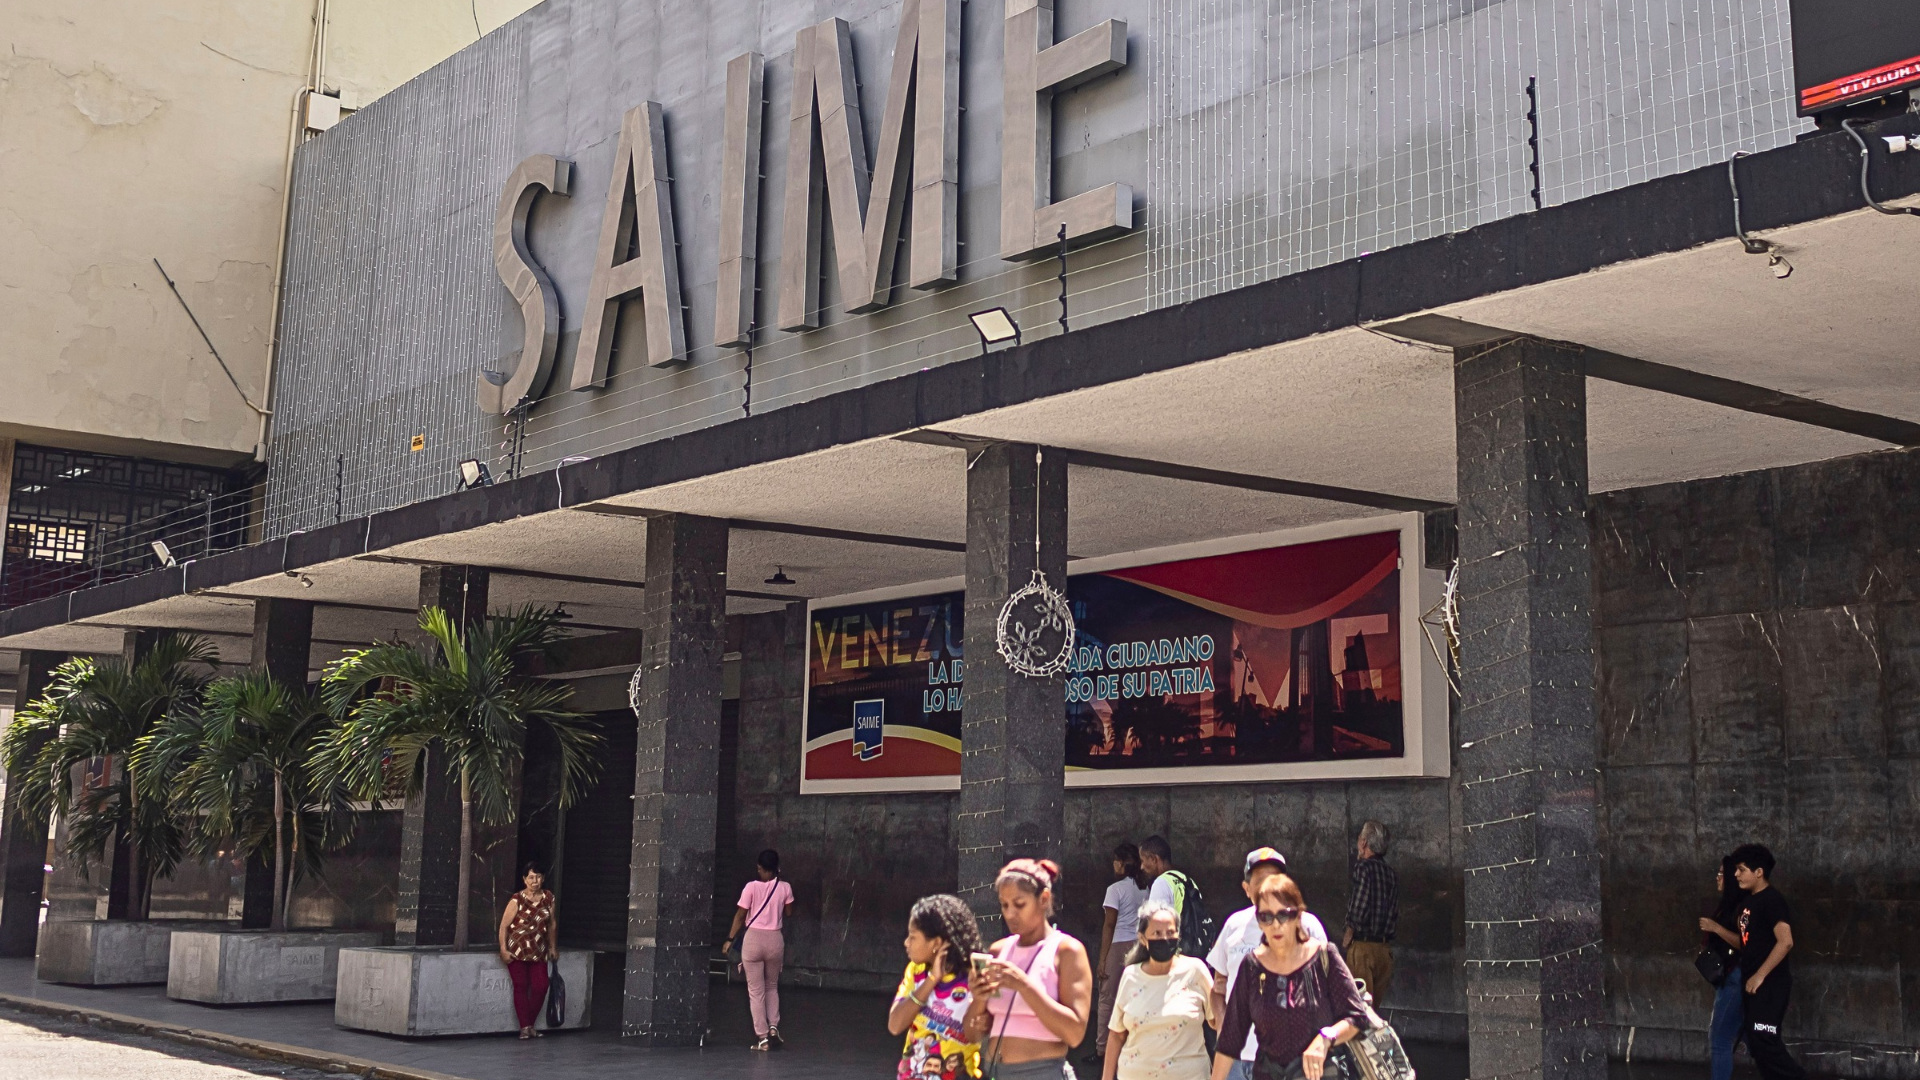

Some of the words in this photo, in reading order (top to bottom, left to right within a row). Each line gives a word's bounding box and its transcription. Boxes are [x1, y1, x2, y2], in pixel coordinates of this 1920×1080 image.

[478, 0, 1133, 414] SAIME
[928, 660, 949, 685] LA
[1106, 634, 1215, 669] CIUDADANO
[923, 689, 945, 713] LO
[1097, 674, 1120, 700] DE
[1122, 671, 1147, 698] SU
[1150, 666, 1215, 697] PATRIA
[857, 715, 881, 730] SAIME
